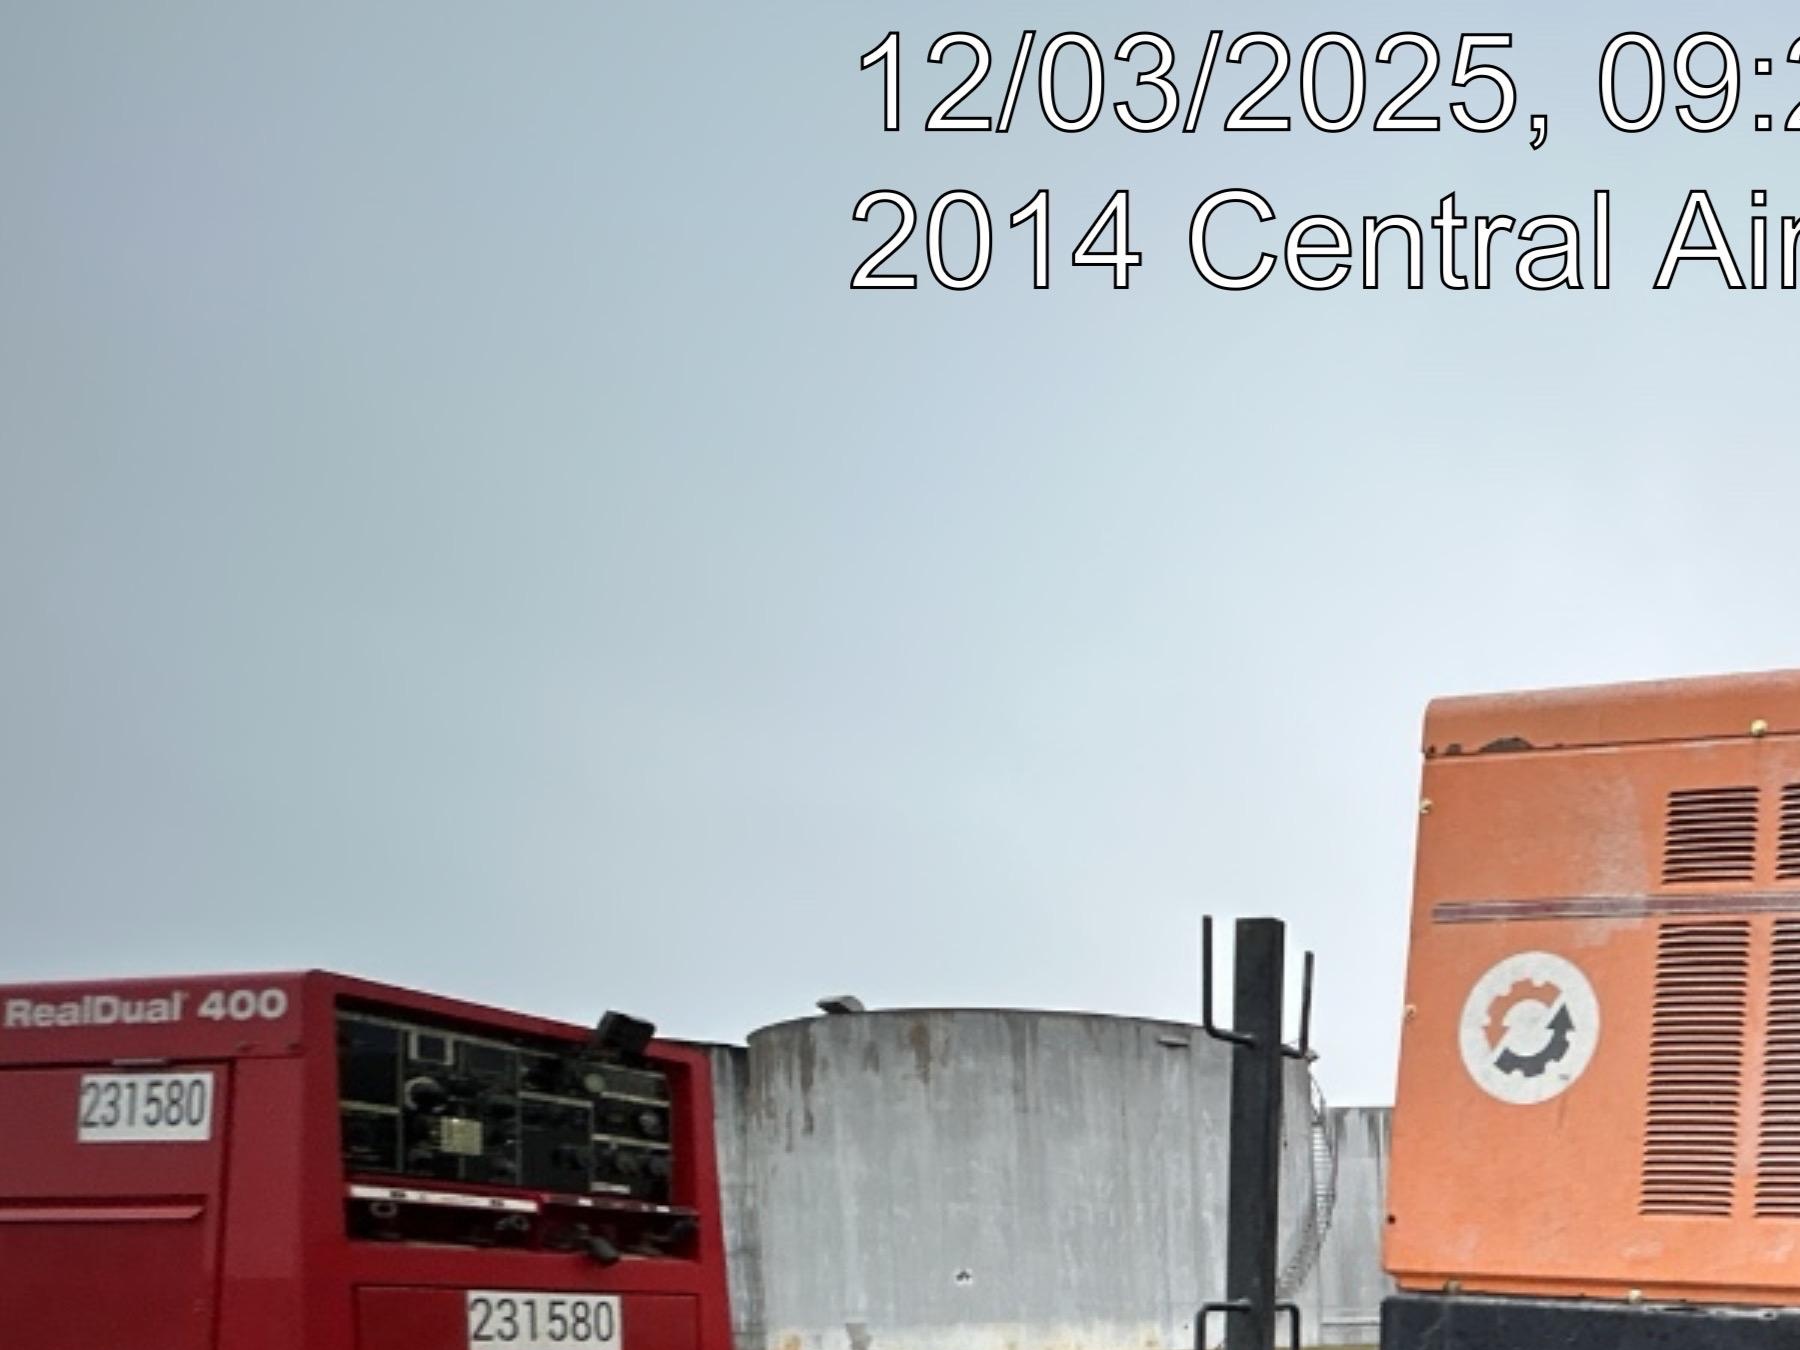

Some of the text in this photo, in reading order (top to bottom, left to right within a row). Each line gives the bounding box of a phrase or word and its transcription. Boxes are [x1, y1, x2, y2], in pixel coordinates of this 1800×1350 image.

[4, 988, 288, 1028] RealDual 400
[80, 1078, 207, 1128] 231580
[469, 1297, 614, 1342] 231580
